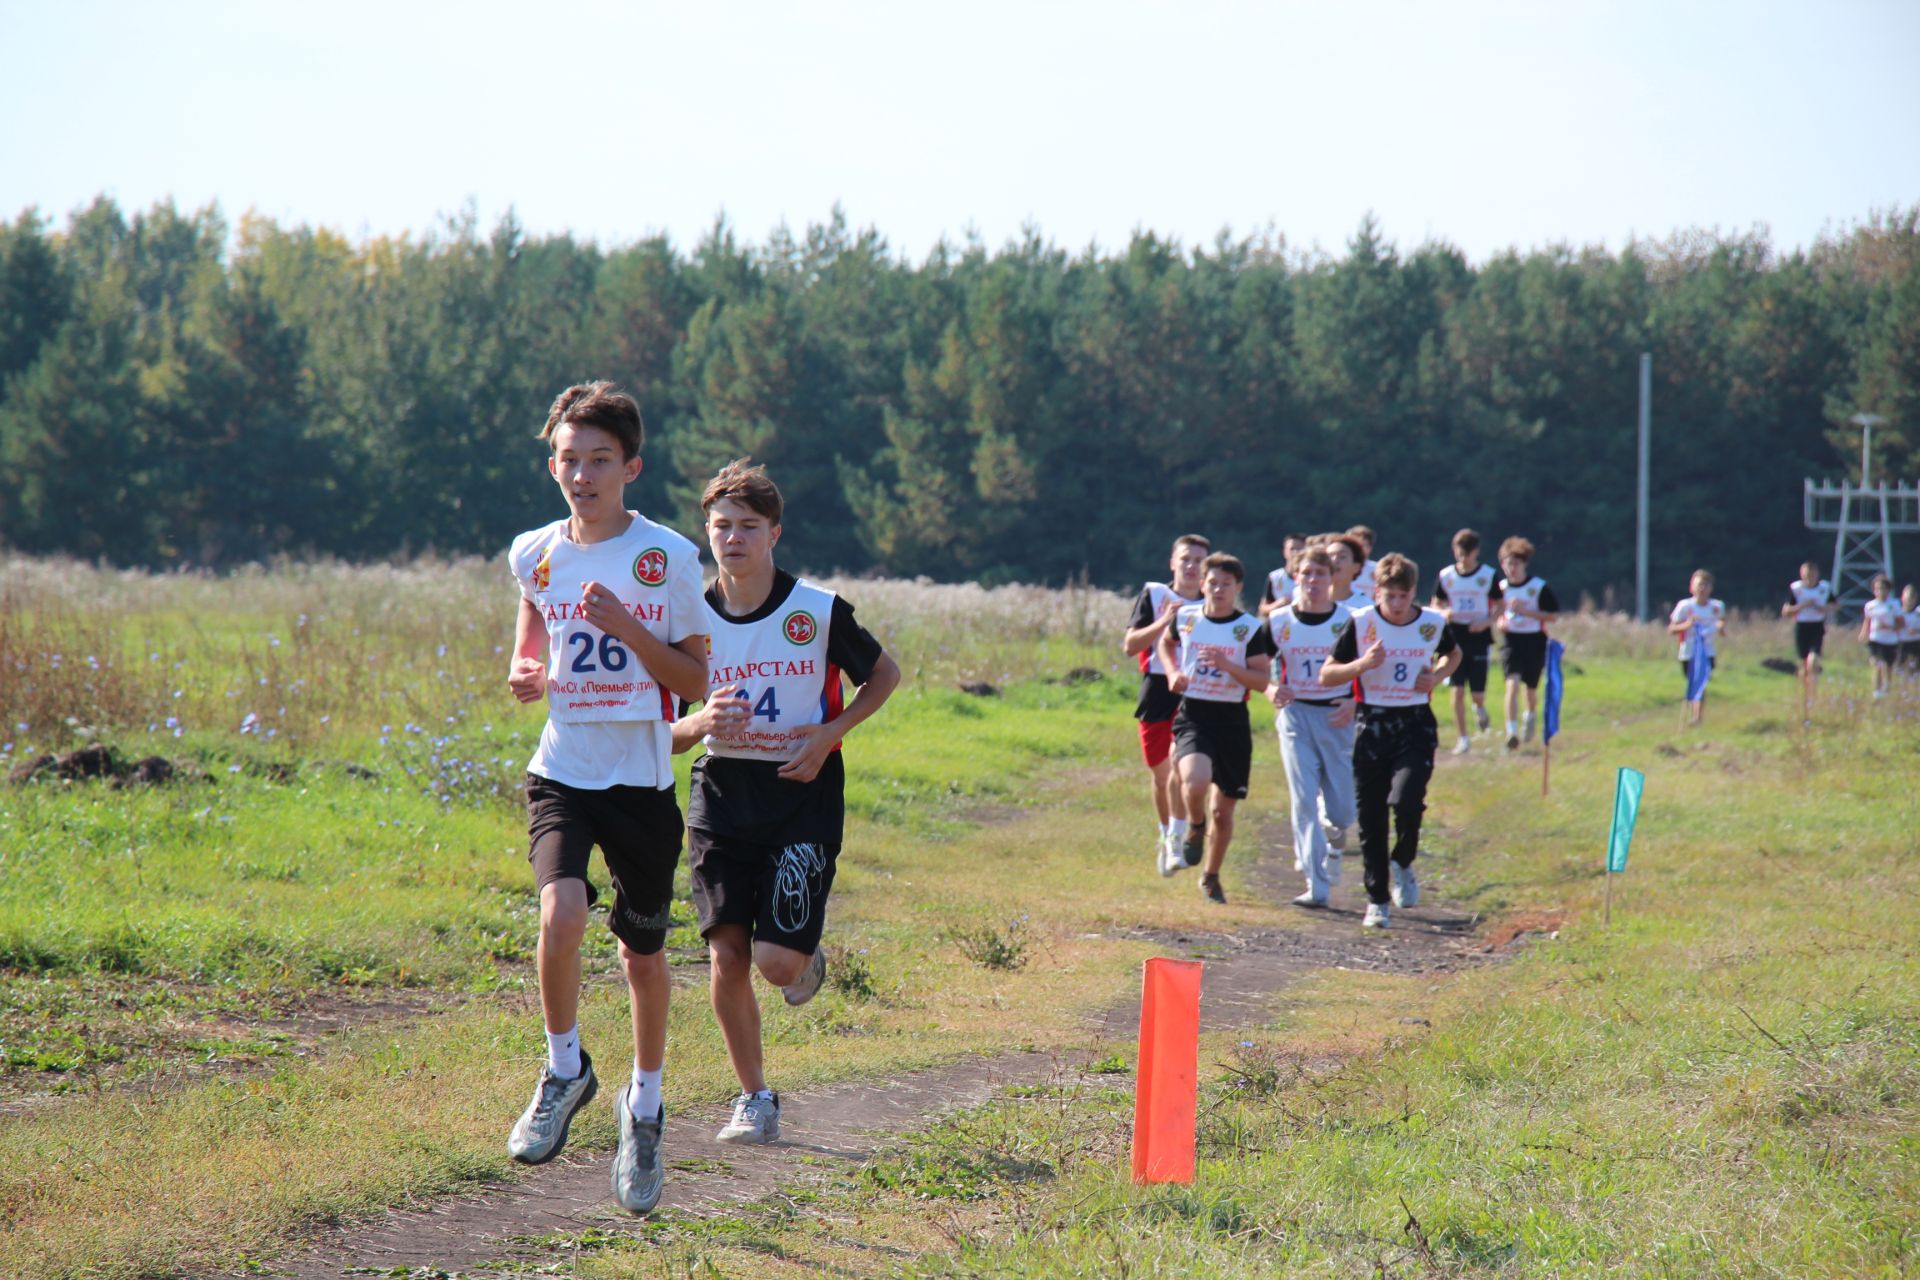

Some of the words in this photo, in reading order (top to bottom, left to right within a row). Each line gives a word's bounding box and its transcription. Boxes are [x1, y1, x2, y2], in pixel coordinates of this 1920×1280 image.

[539, 600, 664, 622] АТААН
[568, 631, 628, 673] 26
[1291, 646, 1330, 655] РОССИ
[1386, 648, 1425, 657] ОССИЯ
[711, 659, 816, 684] АТАРСТАН
[1394, 662, 1408, 682] 8
